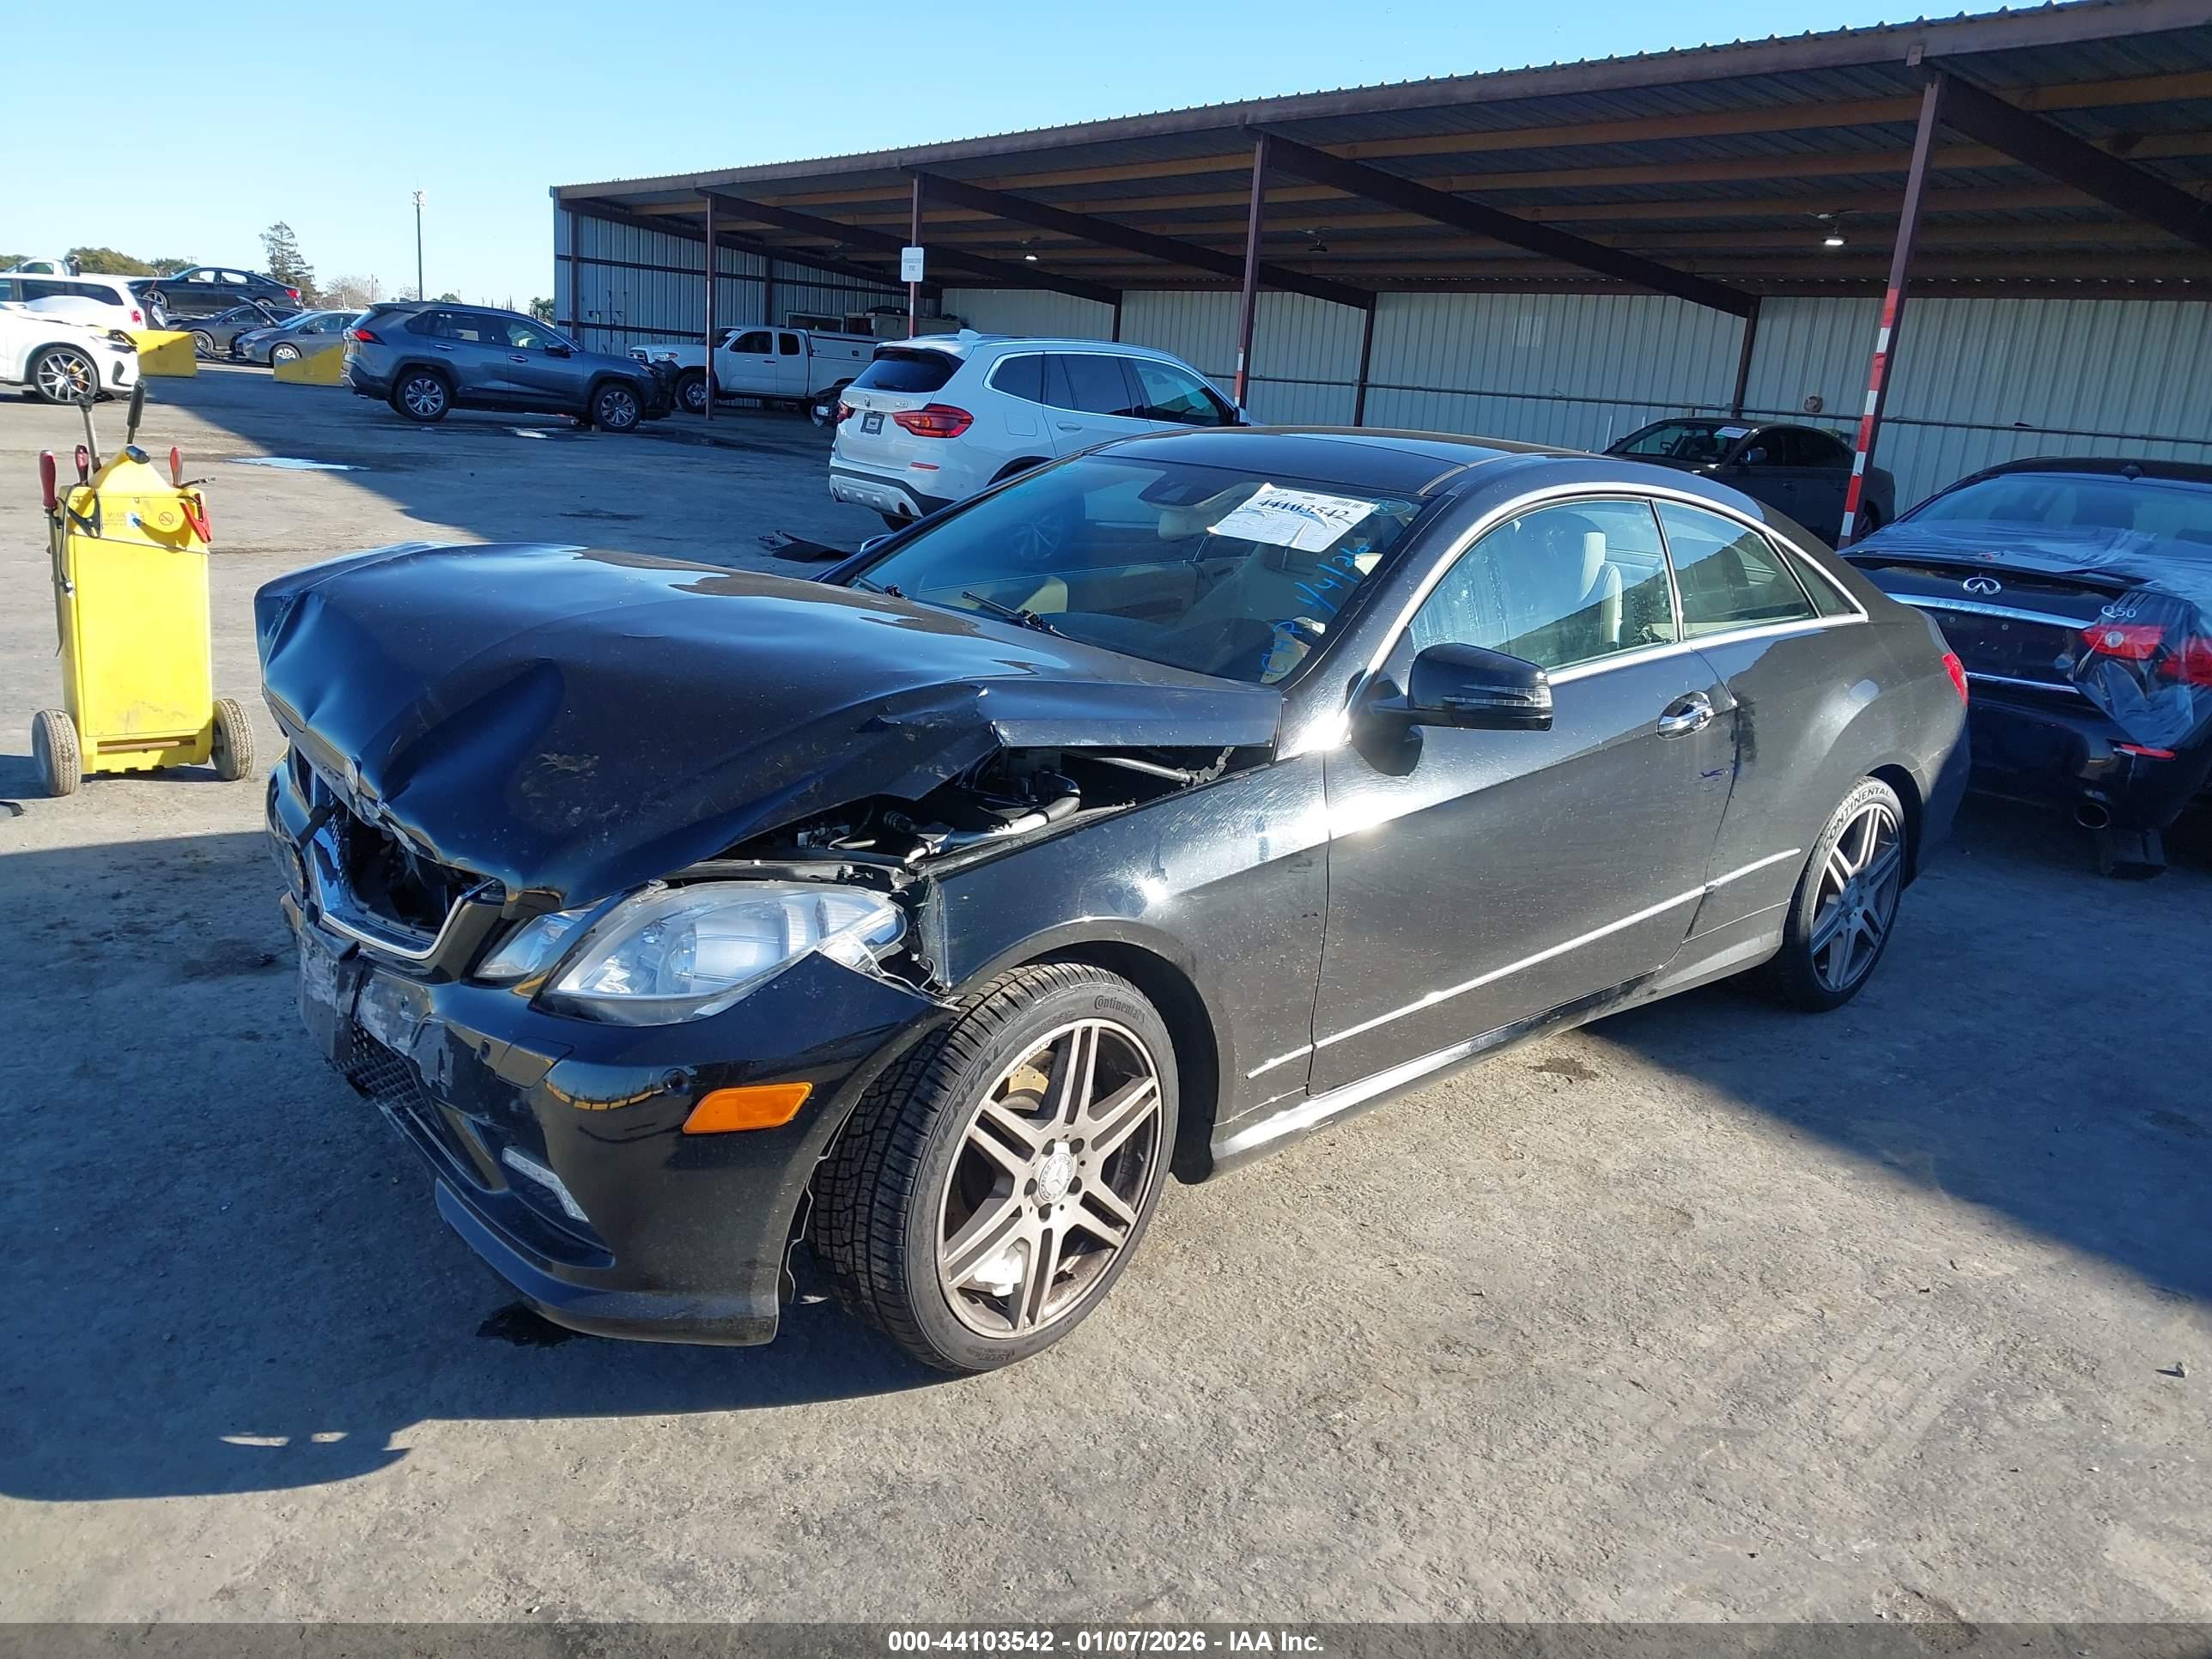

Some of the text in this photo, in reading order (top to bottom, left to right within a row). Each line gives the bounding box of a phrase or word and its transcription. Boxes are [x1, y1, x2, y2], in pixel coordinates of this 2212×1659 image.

[2100, 605, 2137, 619] Q50
[1823, 787, 1891, 852] CONTINENTAL
[1093, 994, 1140, 1020] Continental
